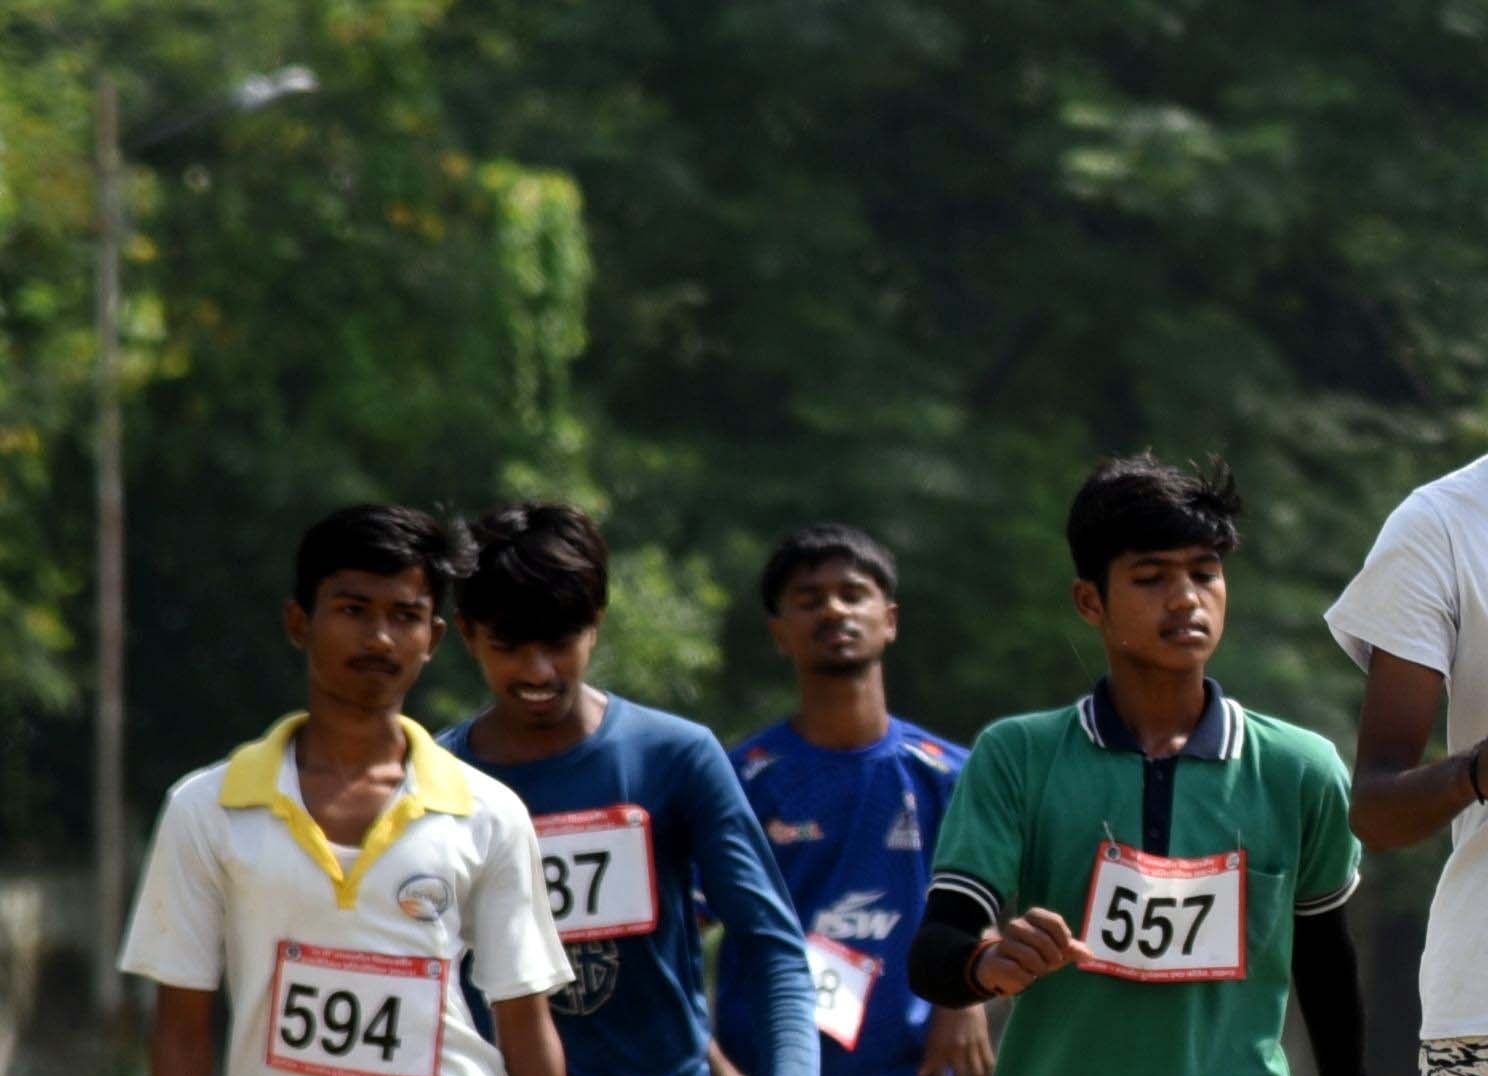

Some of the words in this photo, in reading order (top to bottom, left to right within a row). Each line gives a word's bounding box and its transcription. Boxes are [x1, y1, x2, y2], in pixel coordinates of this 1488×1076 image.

[541, 851, 612, 920] 87
[1101, 885, 1216, 959] 557
[280, 982, 402, 1062] 594
